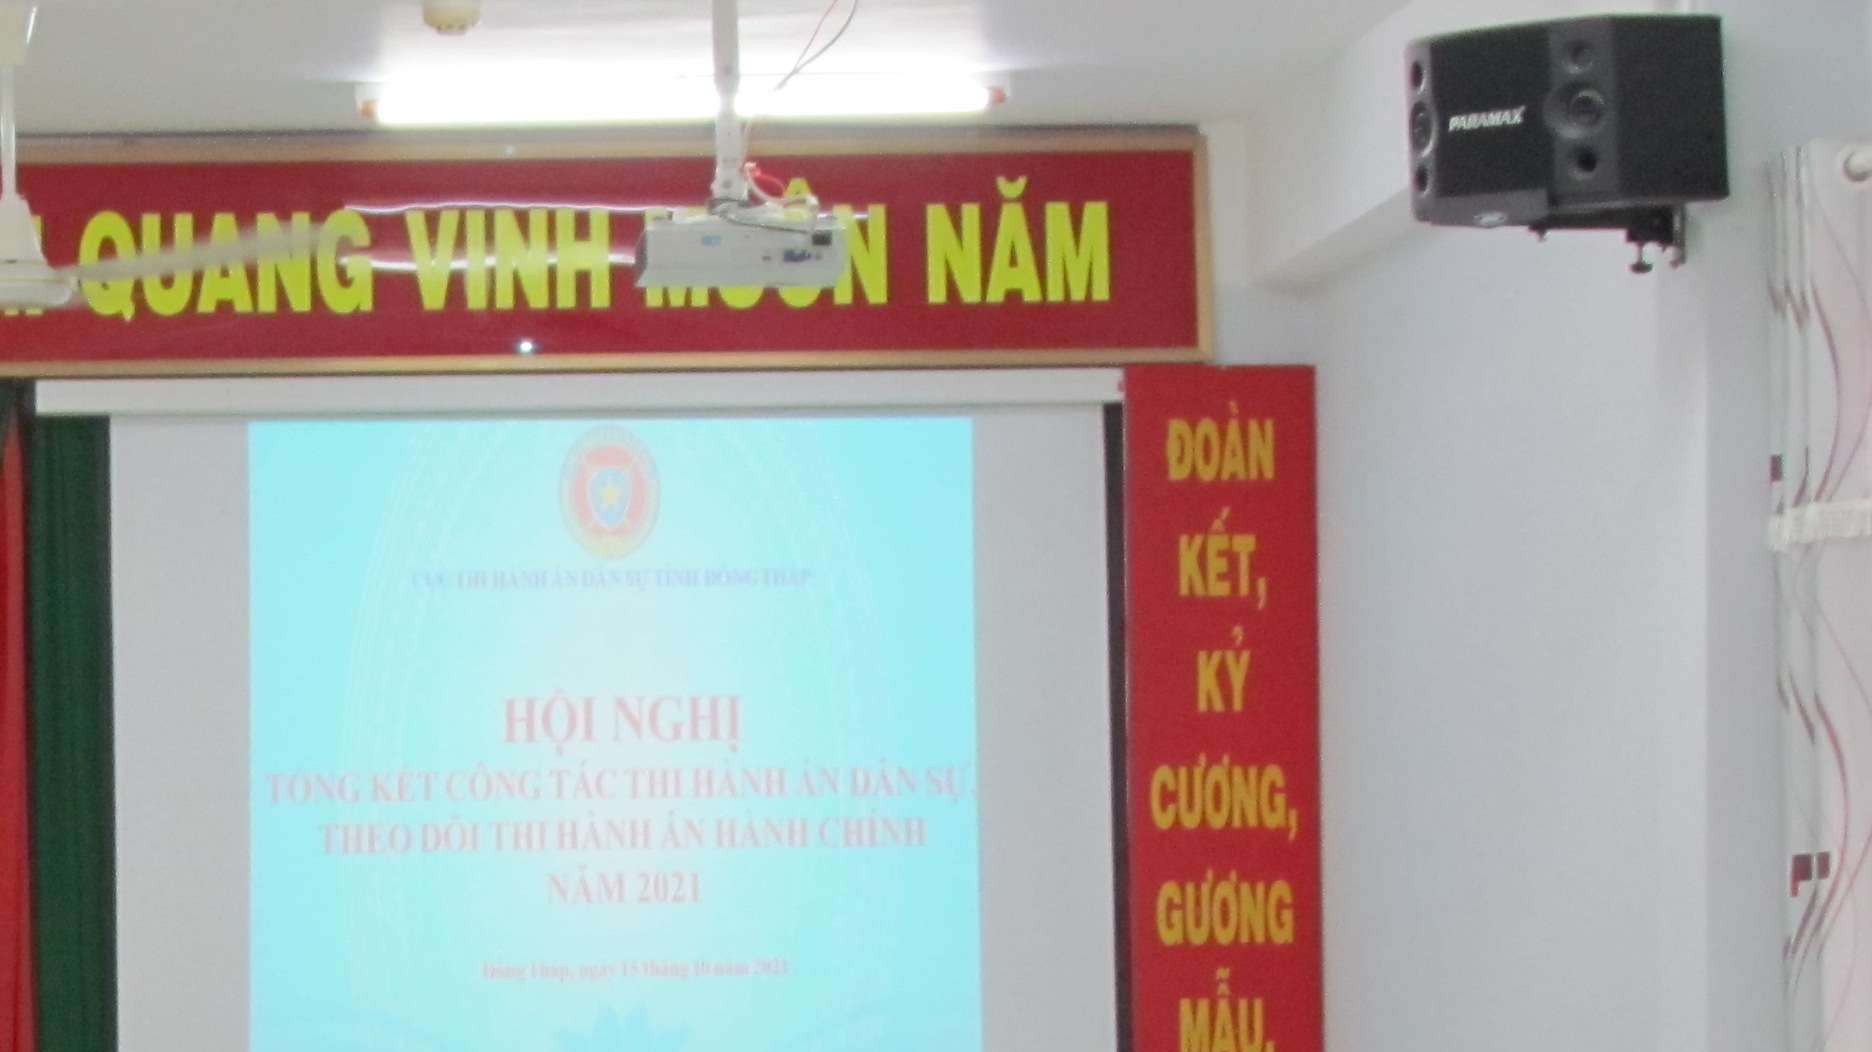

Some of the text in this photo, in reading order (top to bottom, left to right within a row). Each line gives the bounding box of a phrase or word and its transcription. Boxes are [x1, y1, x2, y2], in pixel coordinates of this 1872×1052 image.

[1448, 105, 1526, 132] PARAMAX
[79, 209, 374, 321] QUANG
[405, 207, 611, 310] VINH
[926, 175, 1111, 304] NĂM
[1166, 400, 1276, 481] ĐOÀN
[1178, 507, 1267, 609] KẾT,
[1196, 625, 1251, 713] KỶ
[503, 688, 742, 755] HỘI NGHỊ
[445, 761, 542, 802] CÔNG
[550, 758, 617, 800] TÁC
[624, 767, 684, 799] THI
[1150, 753, 1297, 842] CƯƠNG,
[319, 821, 413, 854] THEO
[489, 820, 548, 852] THI
[546, 864, 701, 904] NĂM 2021
[1156, 868, 1294, 947] GƯƠNG
